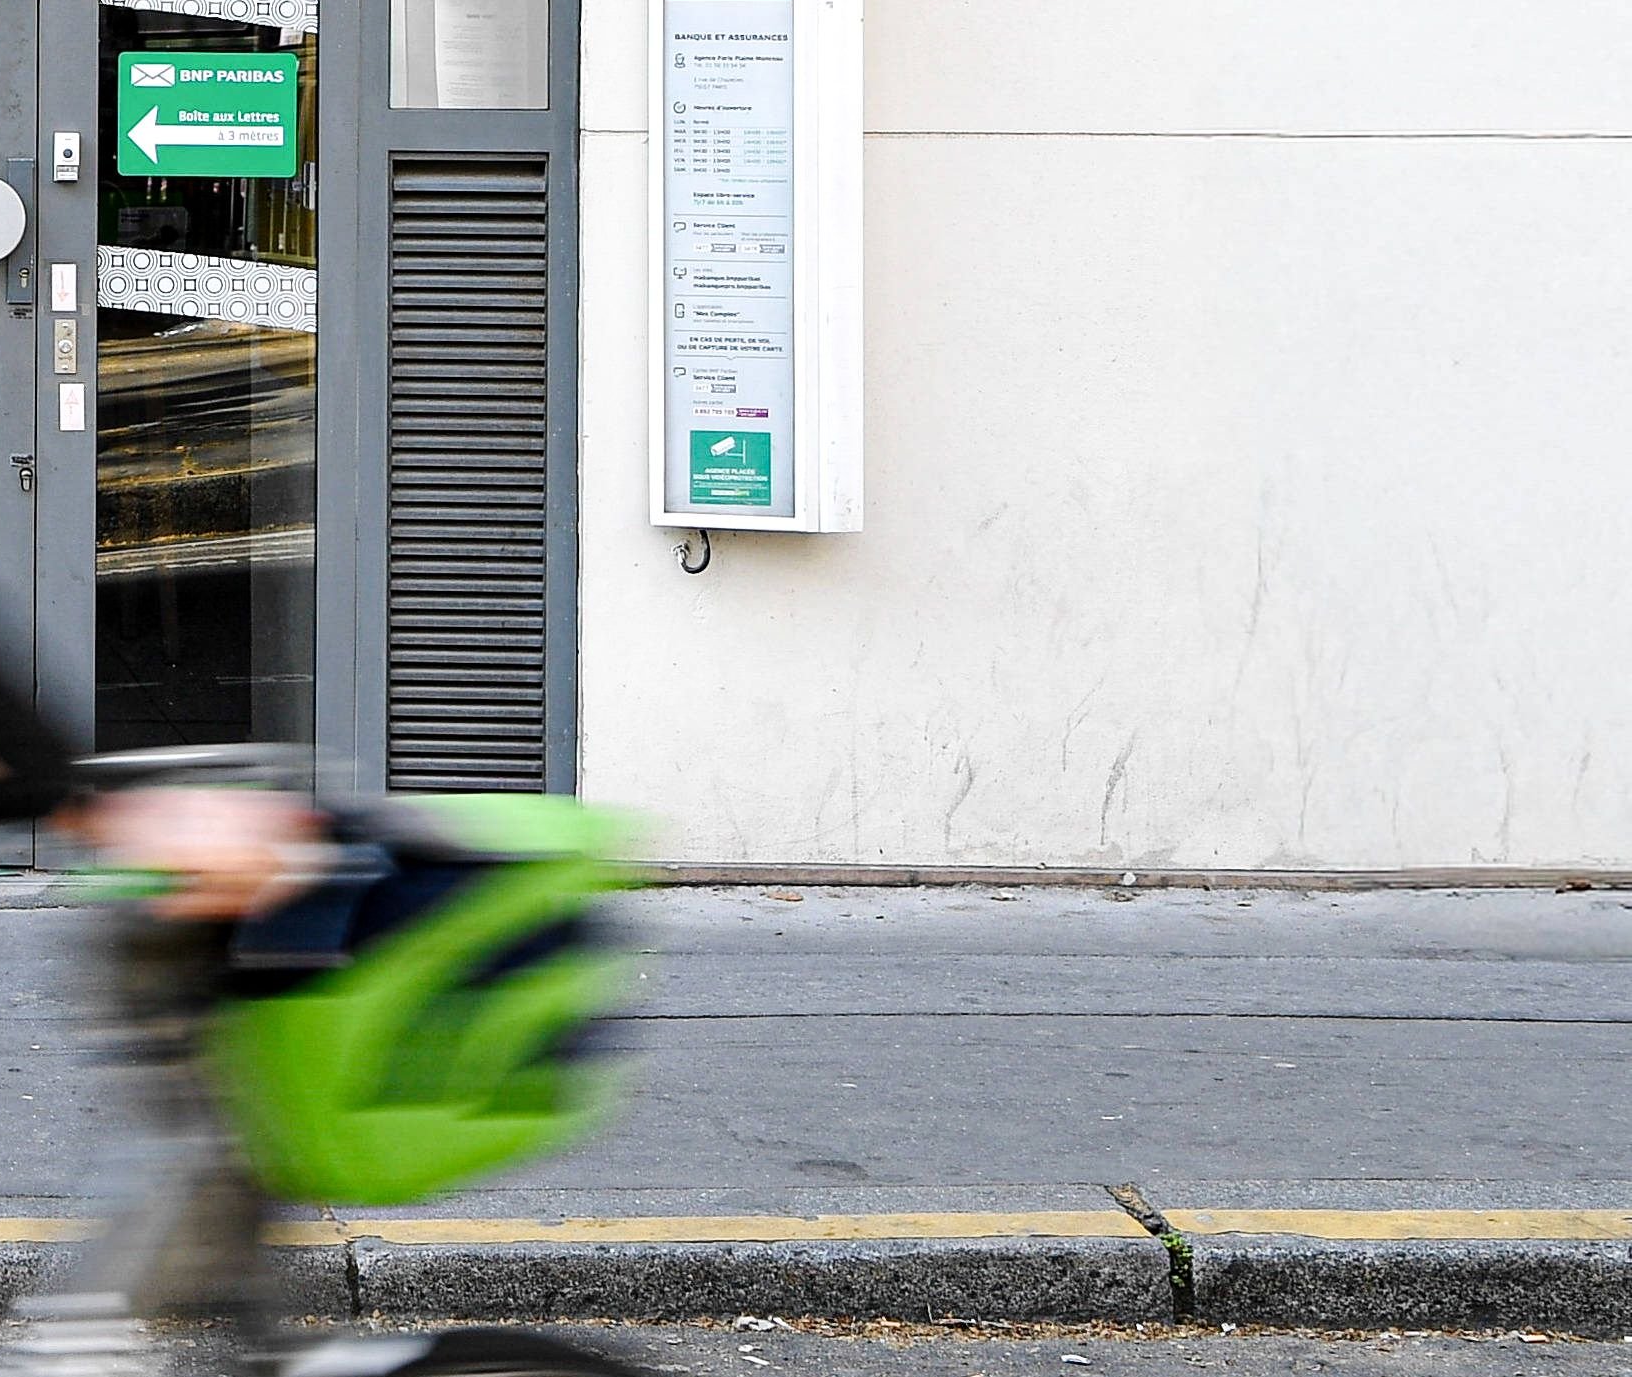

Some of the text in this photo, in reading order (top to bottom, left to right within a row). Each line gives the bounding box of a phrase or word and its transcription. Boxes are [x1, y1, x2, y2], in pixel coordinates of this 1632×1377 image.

[674, 33, 712, 41] BANQUE
[179, 70, 285, 83] BNP PARIBAS
[178, 110, 280, 123] Boîte aux Lettres
[217, 130, 279, 141] à 3 mètres
